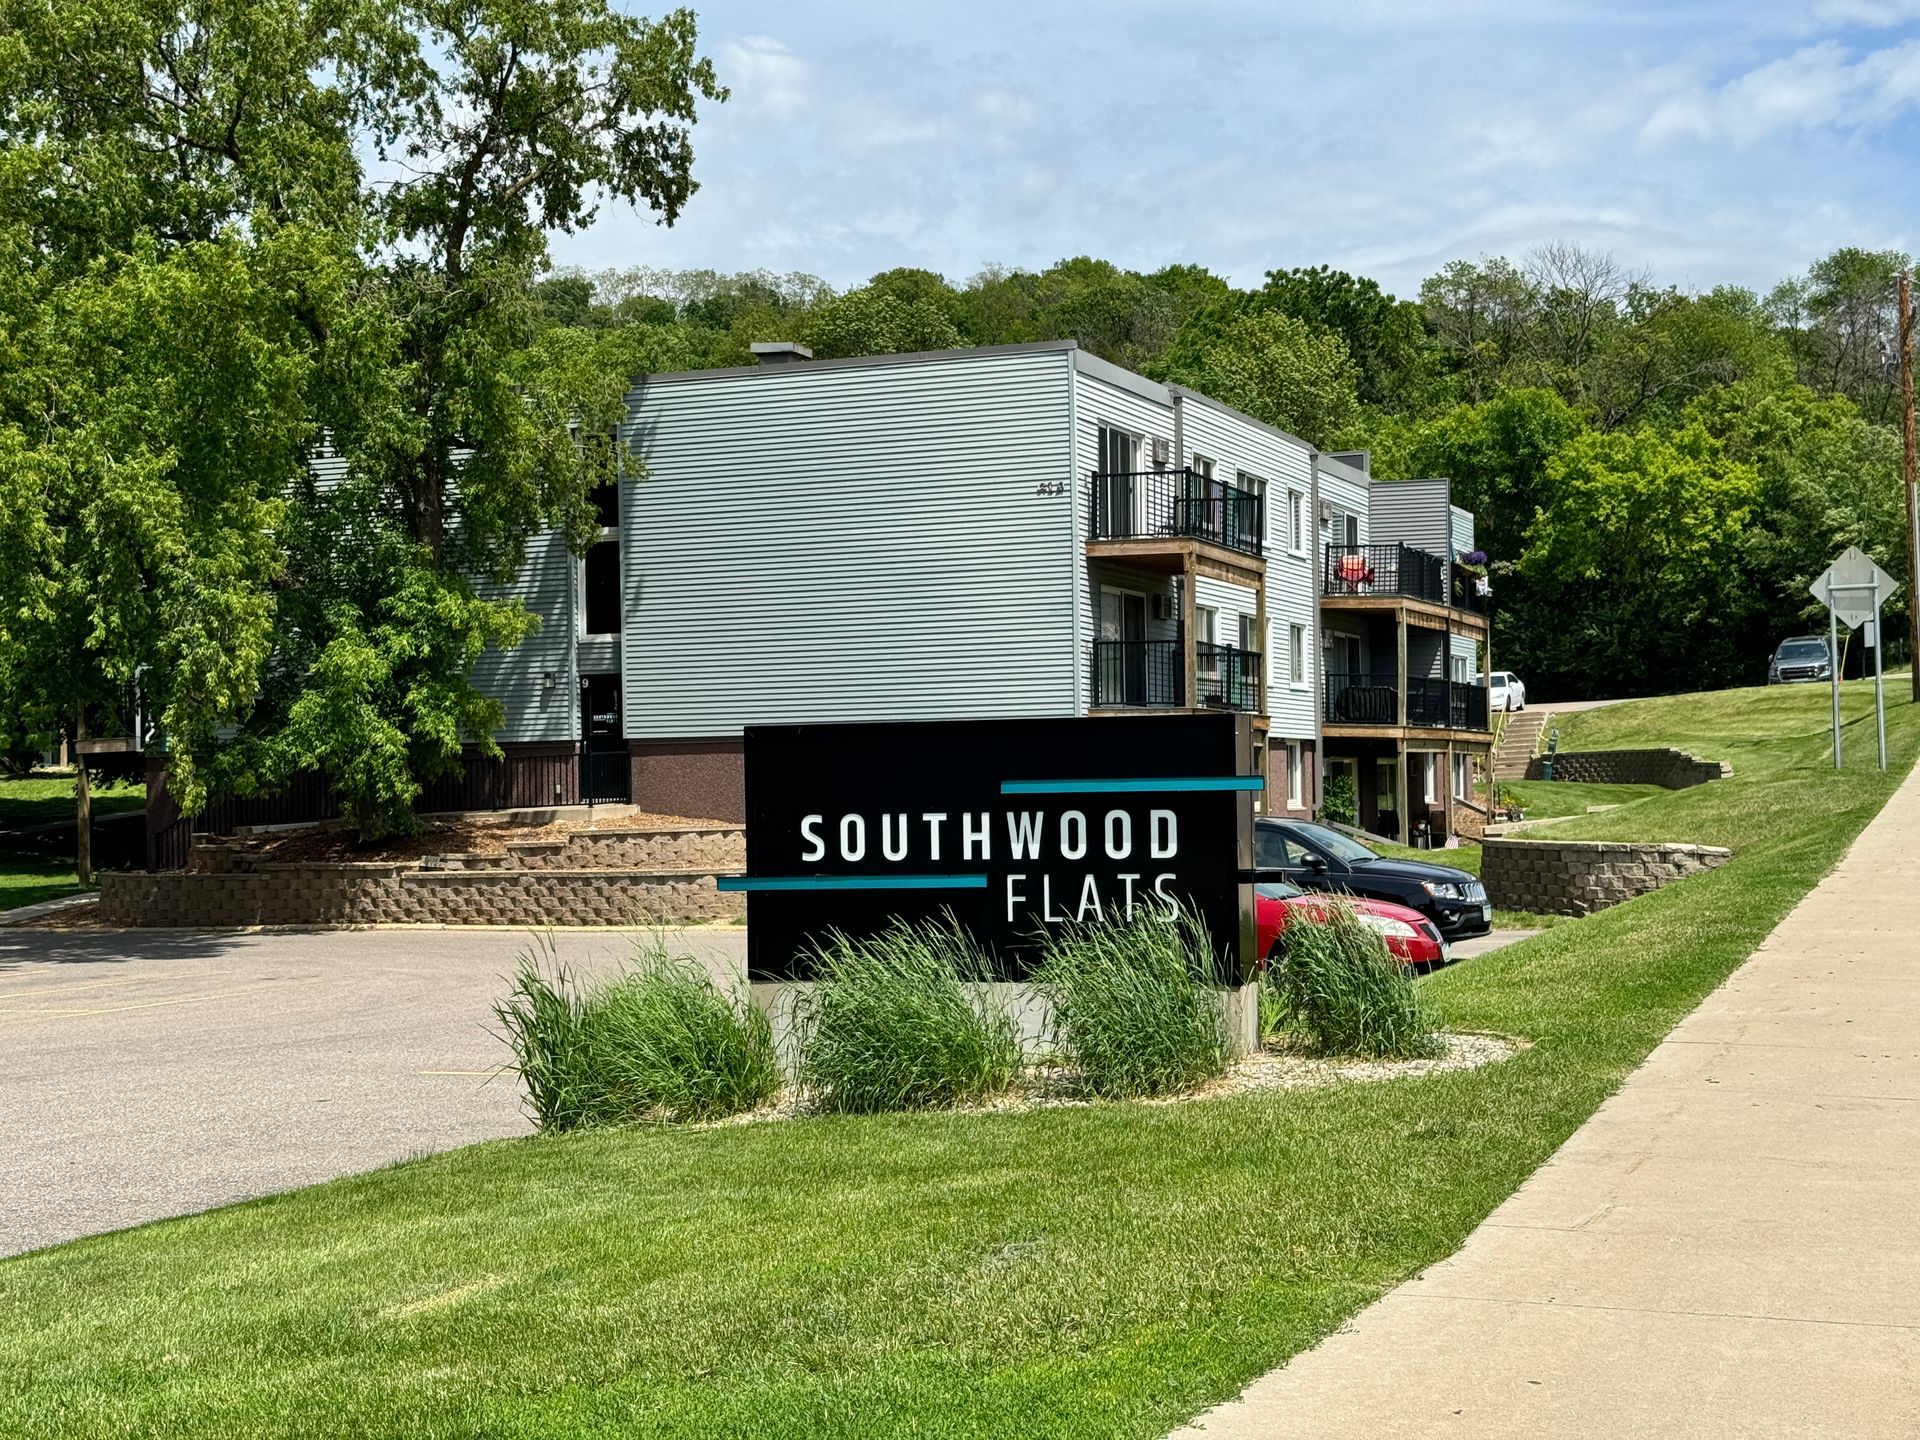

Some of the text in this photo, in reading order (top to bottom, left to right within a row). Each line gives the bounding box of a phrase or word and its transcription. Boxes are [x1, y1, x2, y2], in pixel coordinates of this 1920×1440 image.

[581, 678, 589, 688] 9
[801, 809, 1178, 862] SOUTHWOOD
[1007, 873, 1179, 923] FLATS
